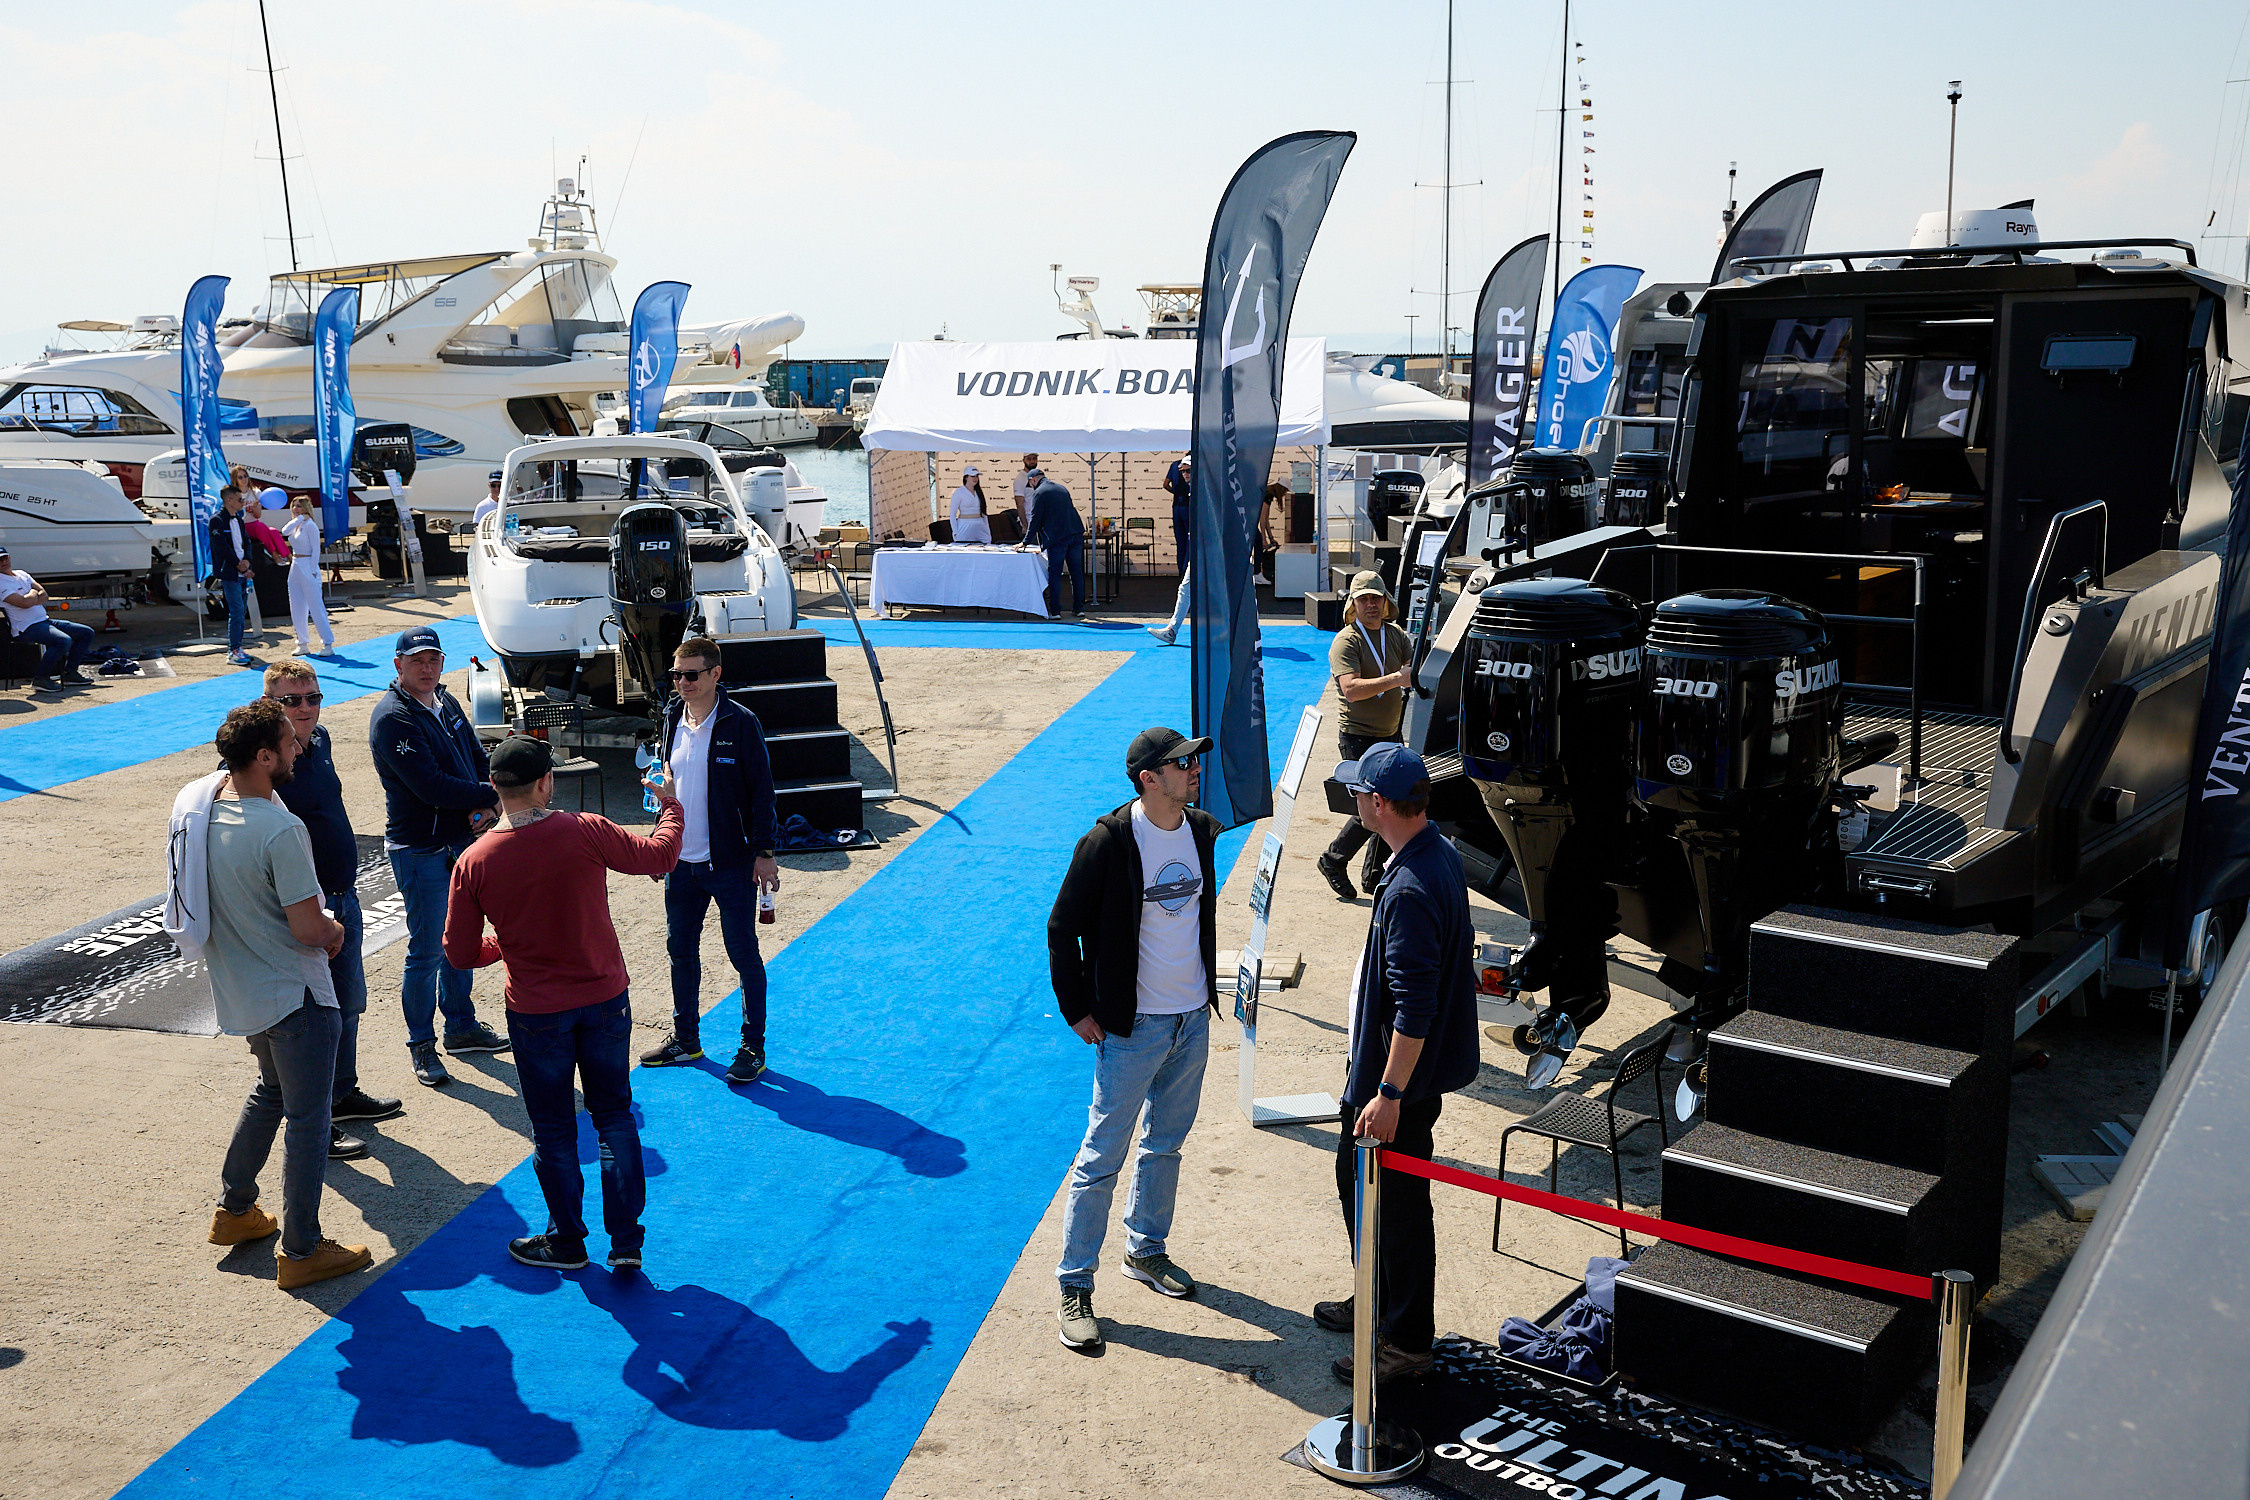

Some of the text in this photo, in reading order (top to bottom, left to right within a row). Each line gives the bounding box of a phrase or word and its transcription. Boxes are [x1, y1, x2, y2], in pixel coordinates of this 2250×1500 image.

[957, 367, 1204, 396] VODNIK.BOA
[1489, 305, 1526, 481] YAGER
[365, 436, 408, 446] SUZUKI
[158, 470, 187, 479] SUZ
[287, 474, 299, 482] HT
[1387, 484, 1420, 493] SUZUKI
[1514, 488, 1546, 497] 30
[1614, 488, 1648, 498] 300
[27, 495, 41, 504] 25
[43, 498, 57, 506] HT
[638, 540, 670, 551] 150
[1474, 658, 1533, 680] 300
[1588, 647, 1643, 681] SUZU
[1652, 677, 1718, 699] 300
[1775, 658, 1840, 698] SUZUKI
[2201, 667, 2250, 802] VENT
[1491, 1404, 1567, 1437] THE
[1434, 1443, 1612, 1500] OUTBO
